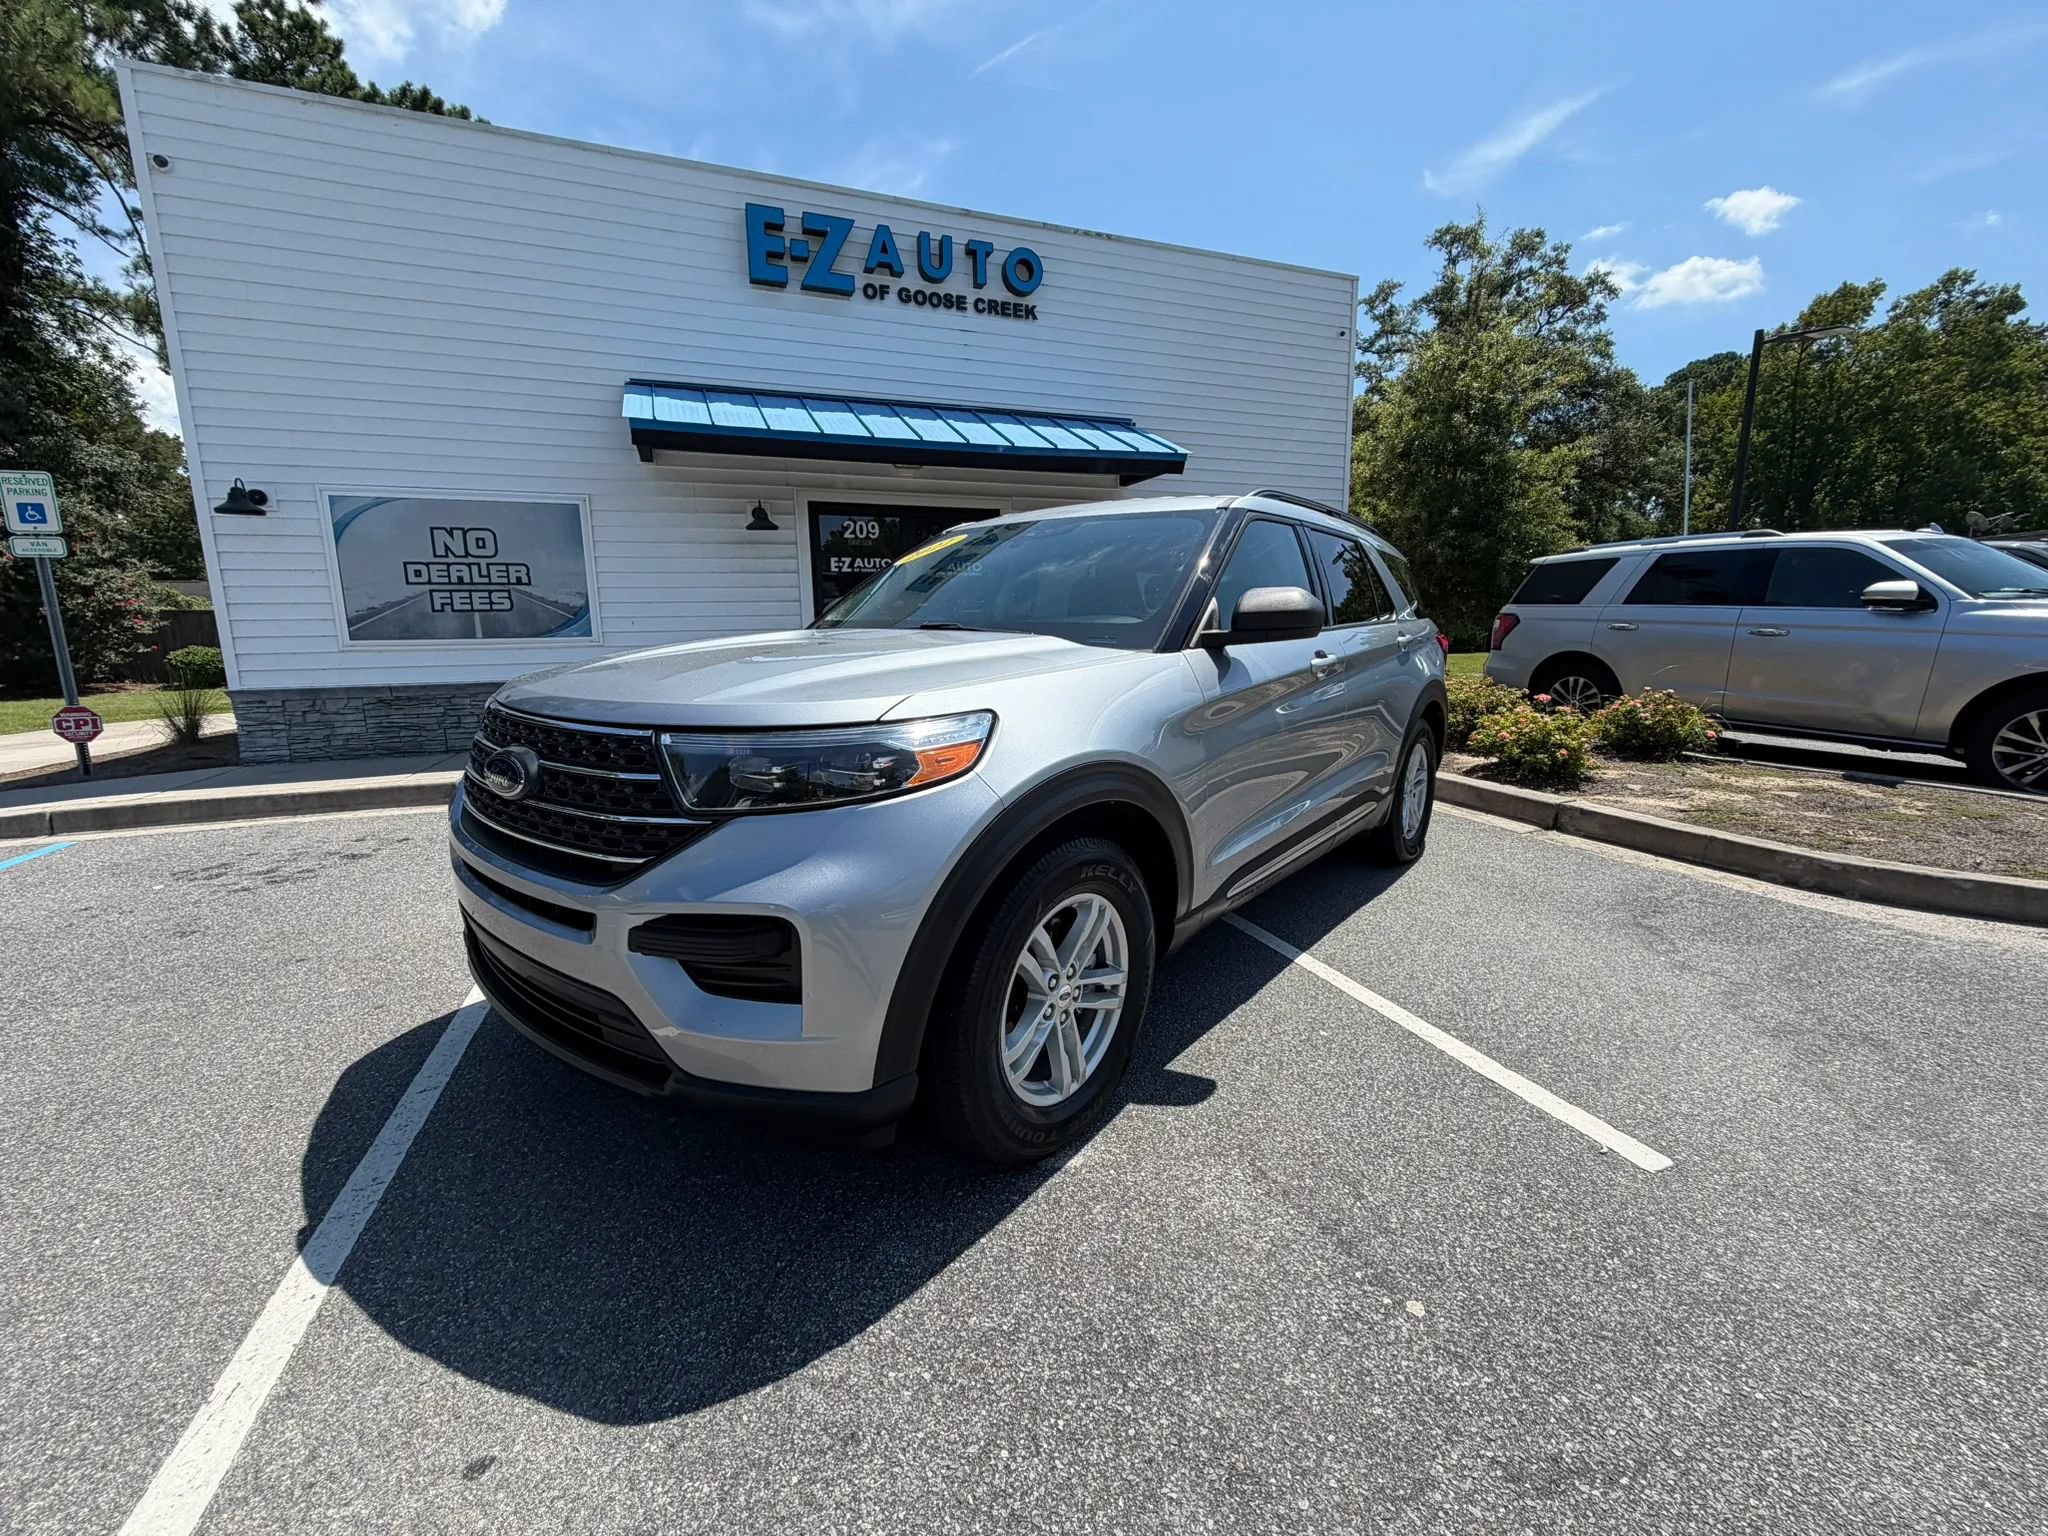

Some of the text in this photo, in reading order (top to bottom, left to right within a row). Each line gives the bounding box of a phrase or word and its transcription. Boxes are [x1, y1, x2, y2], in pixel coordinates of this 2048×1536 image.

[745, 202, 1044, 297] E-Z AUTO
[862, 283, 1039, 320] OF GOOSE CREEK
[1, 476, 48, 486] RESERVED
[7, 488, 48, 497] PARKING
[430, 526, 499, 558] NO
[843, 520, 880, 539] 209
[403, 561, 531, 586] DEALER
[830, 557, 892, 573] E-Z AUTO
[428, 588, 514, 613] FEES
[55, 718, 100, 731] CPI
[1080, 863, 1138, 894] KELLY
